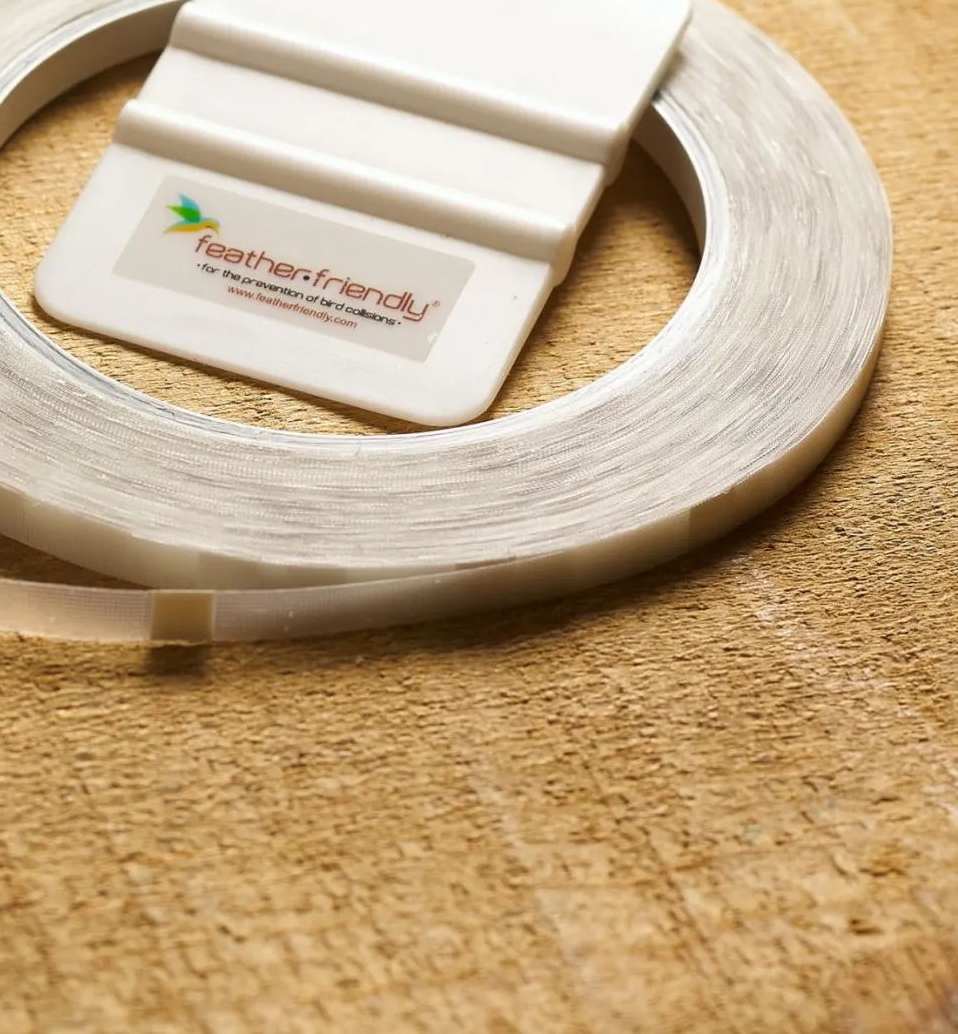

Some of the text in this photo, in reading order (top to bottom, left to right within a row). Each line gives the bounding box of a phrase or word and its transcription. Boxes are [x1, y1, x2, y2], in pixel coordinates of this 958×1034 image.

[222, 269, 241, 281] the
[241, 276, 304, 299] prevention
[305, 295, 320, 304] of
[320, 297, 346, 311] bird
[227, 285, 358, 329] www.featherfriendly.com
